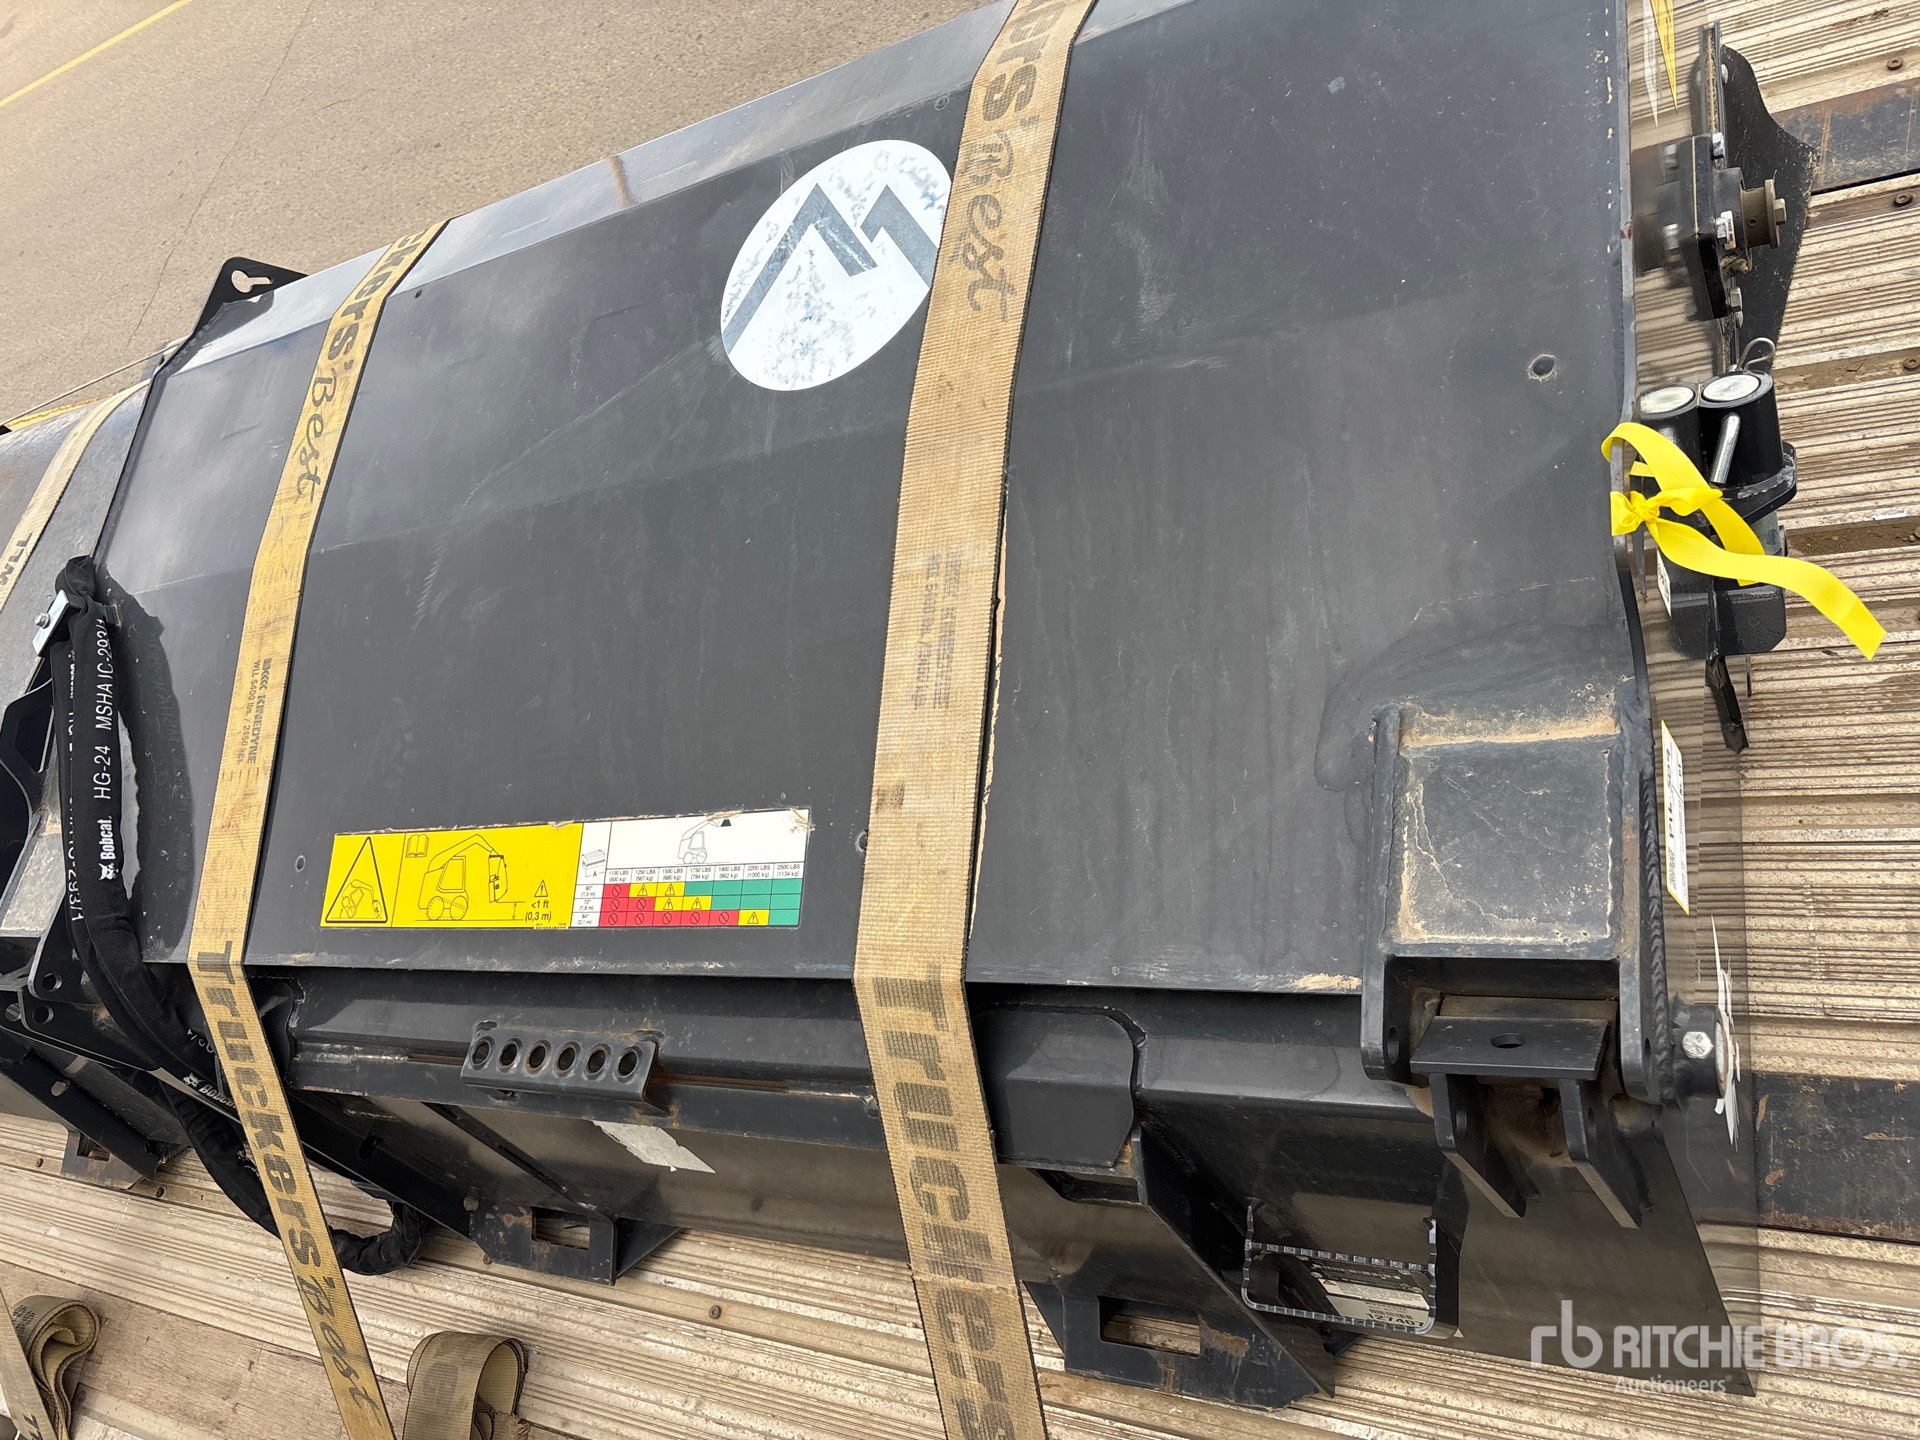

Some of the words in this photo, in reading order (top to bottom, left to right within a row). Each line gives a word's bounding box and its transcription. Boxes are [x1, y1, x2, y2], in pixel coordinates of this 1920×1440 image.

[983, 0, 1066, 128] ers'
[297, 366, 340, 503] Best
[95, 683, 114, 730] MSHA
[93, 745, 112, 799] HG-24
[525, 911, 540, 922] (0,3
[541, 911, 551, 922] m)
[543, 899, 549, 909] ft
[197, 941, 337, 1289] Truckers'
[296, 1272, 384, 1430] Best
